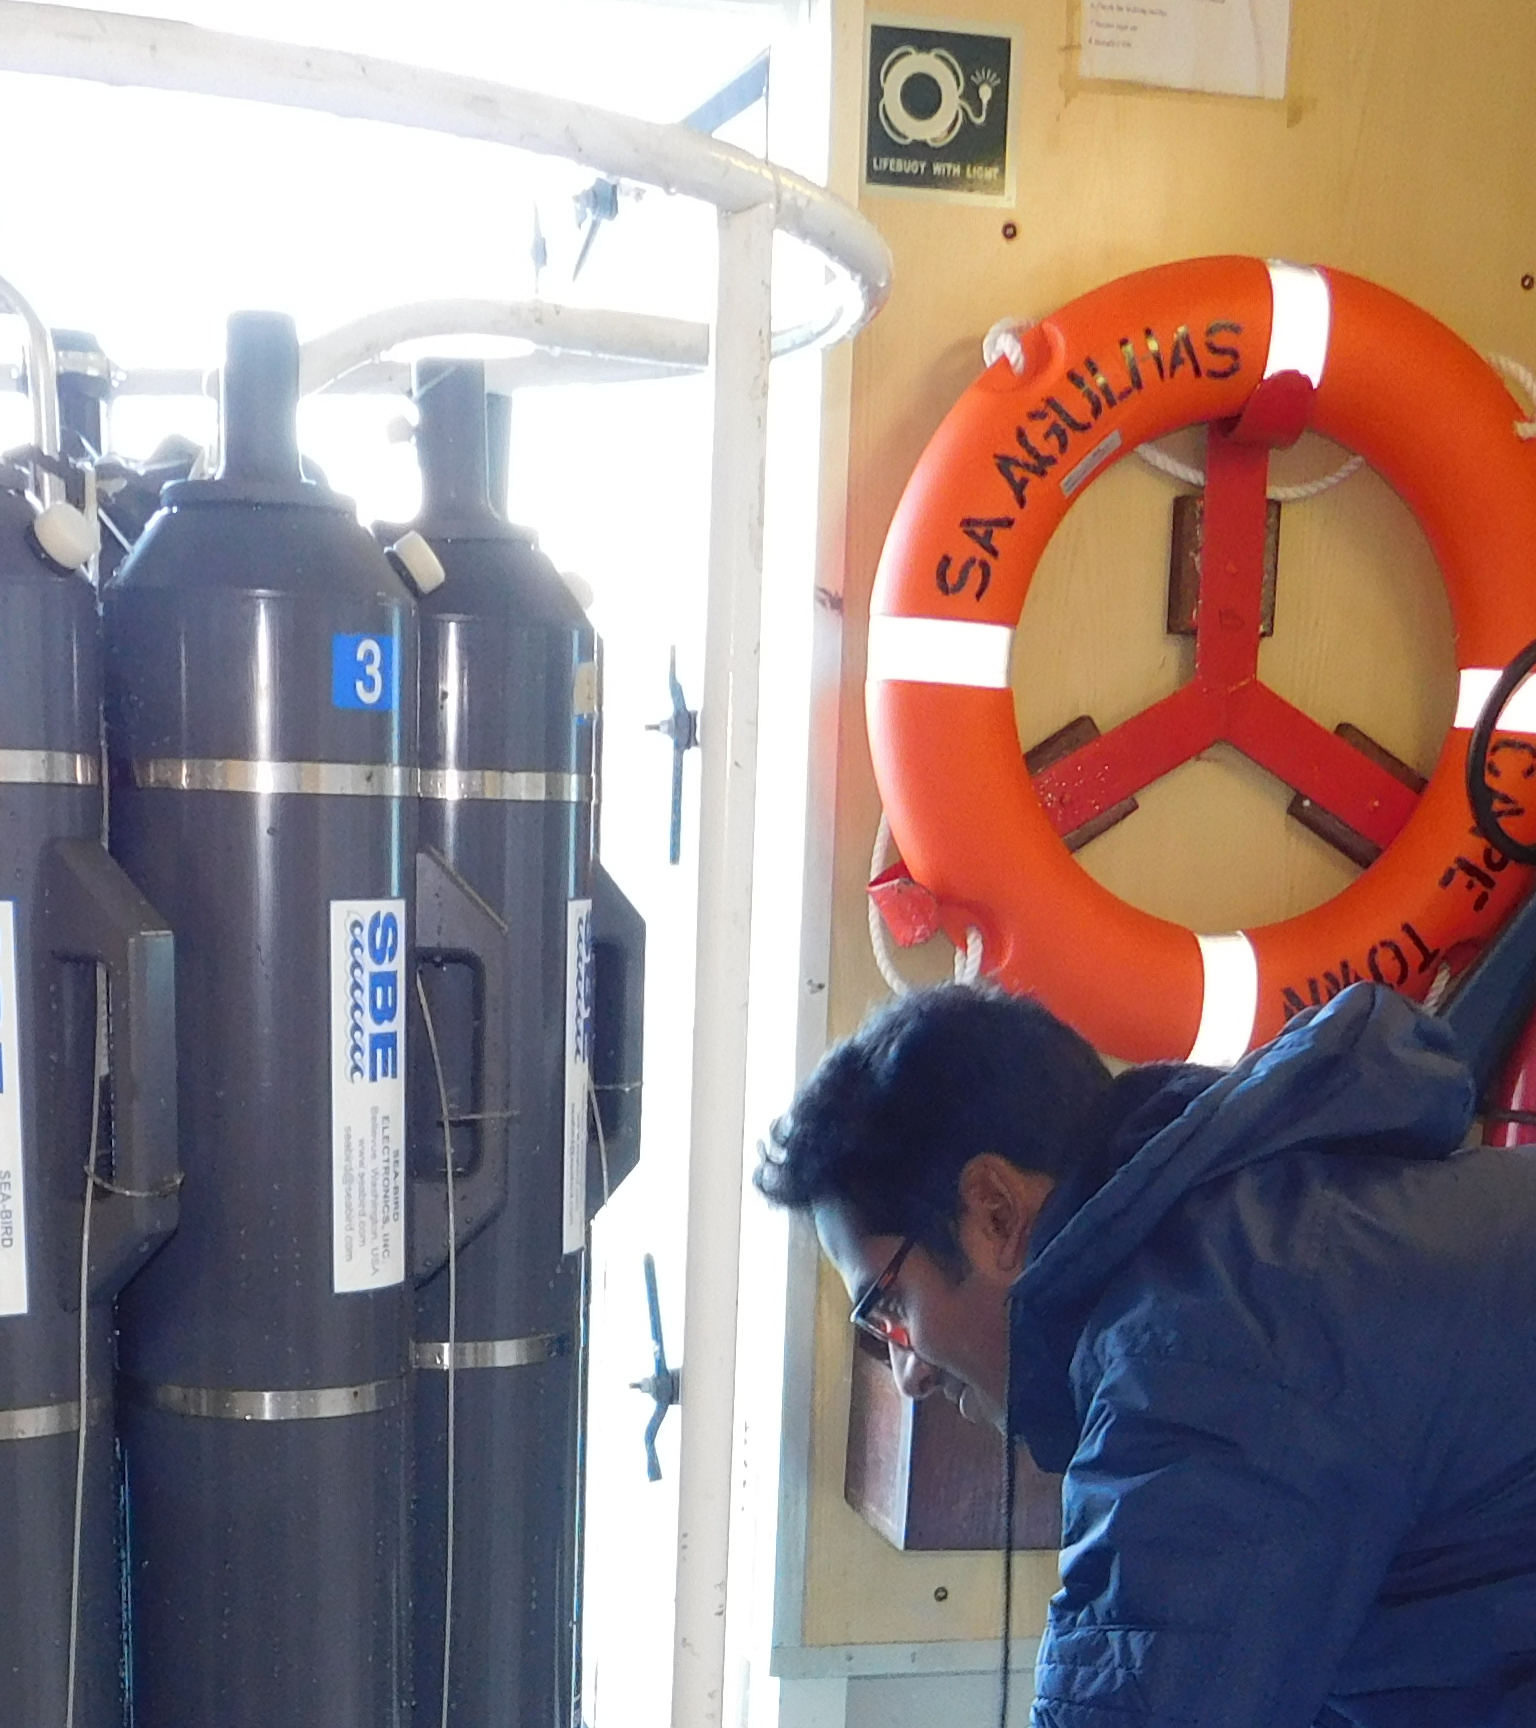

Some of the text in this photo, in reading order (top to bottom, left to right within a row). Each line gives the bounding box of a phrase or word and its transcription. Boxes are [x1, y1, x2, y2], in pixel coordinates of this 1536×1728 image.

[872, 156, 1001, 181] LIFEBUOY WITH LIGHT
[935, 320, 1243, 602] SA AGULHAS
[355, 638, 383, 704] 3
[367, 910, 399, 1083] SBE
[380, 1114, 392, 1230] ELECTRONICS,
[392, 1148, 401, 1223] SEA-BIRD
[370, 1246, 381, 1277] USA
